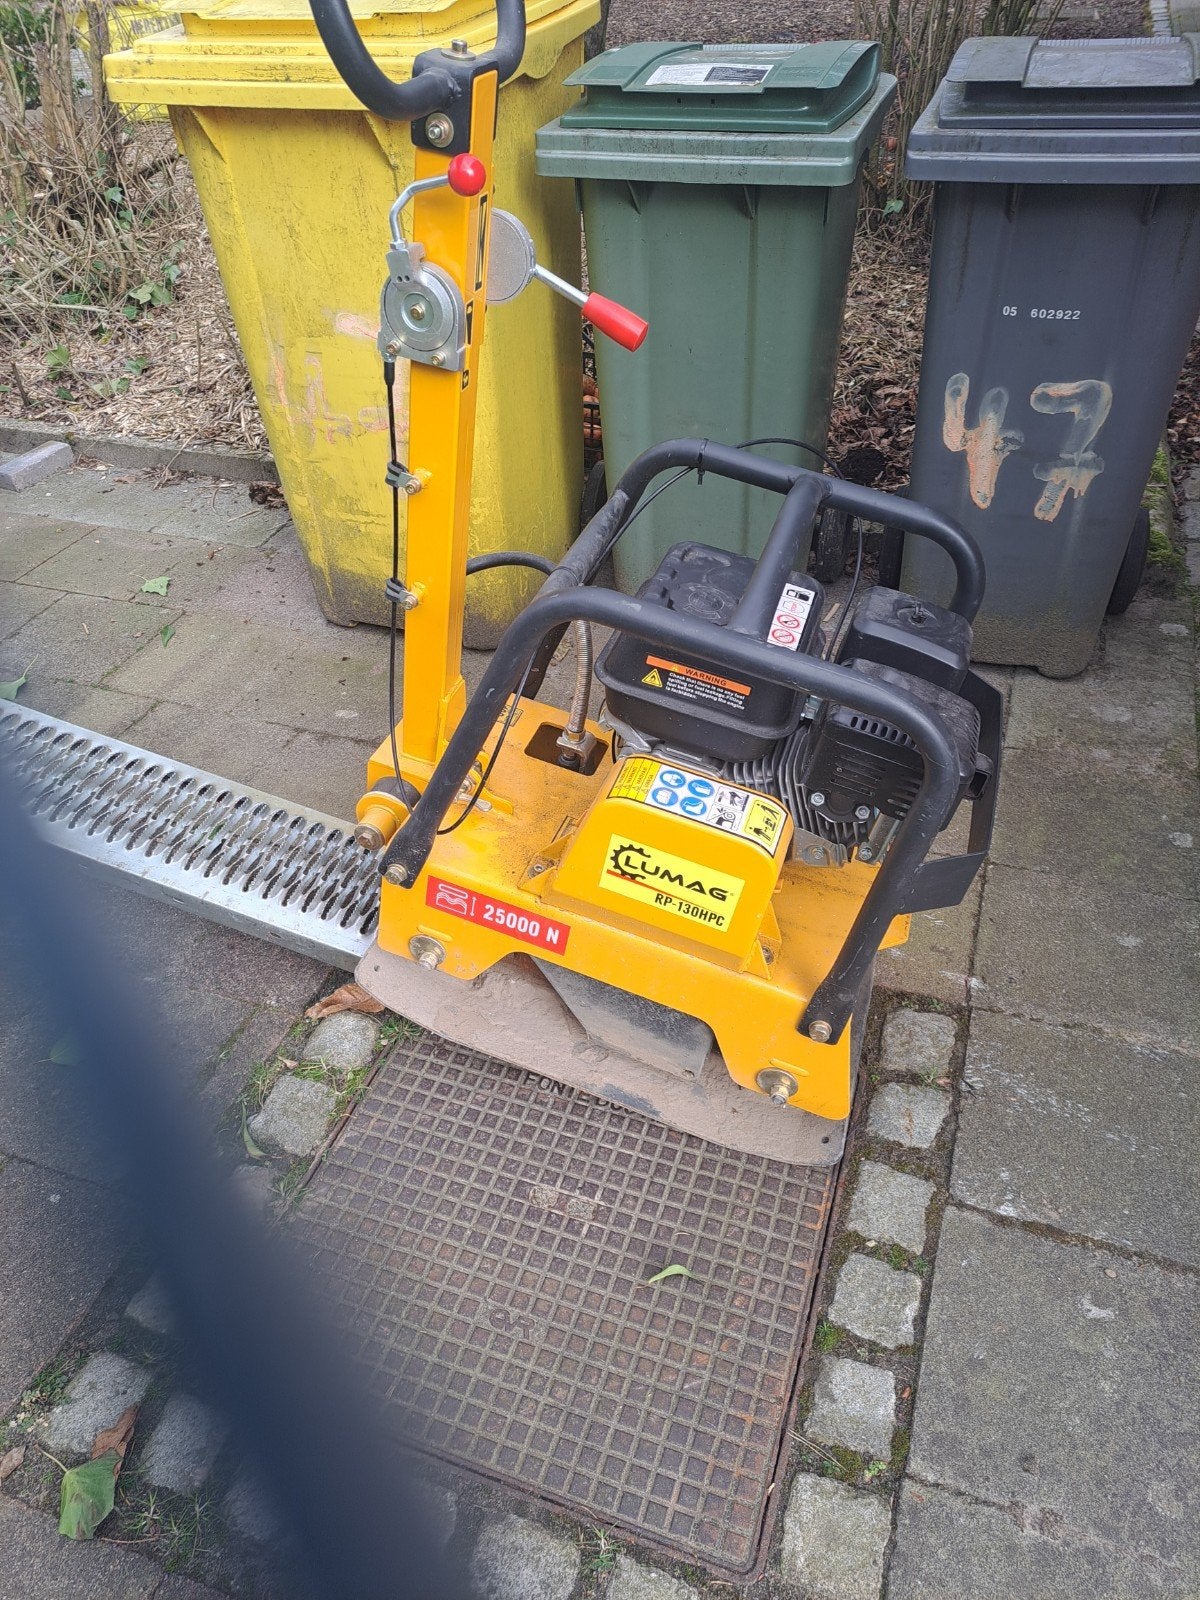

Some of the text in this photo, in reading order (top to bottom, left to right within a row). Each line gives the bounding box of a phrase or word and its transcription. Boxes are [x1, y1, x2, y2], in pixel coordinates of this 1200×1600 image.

[1002, 305, 1081, 320] 05 602922
[942, 372, 1113, 522] 47
[668, 672, 686, 681] Check
[684, 668, 728, 687] WARNING
[624, 855, 729, 901] LUMAG
[483, 904, 560, 944] 25000 N
[654, 893, 725, 927] RP-130HPC
